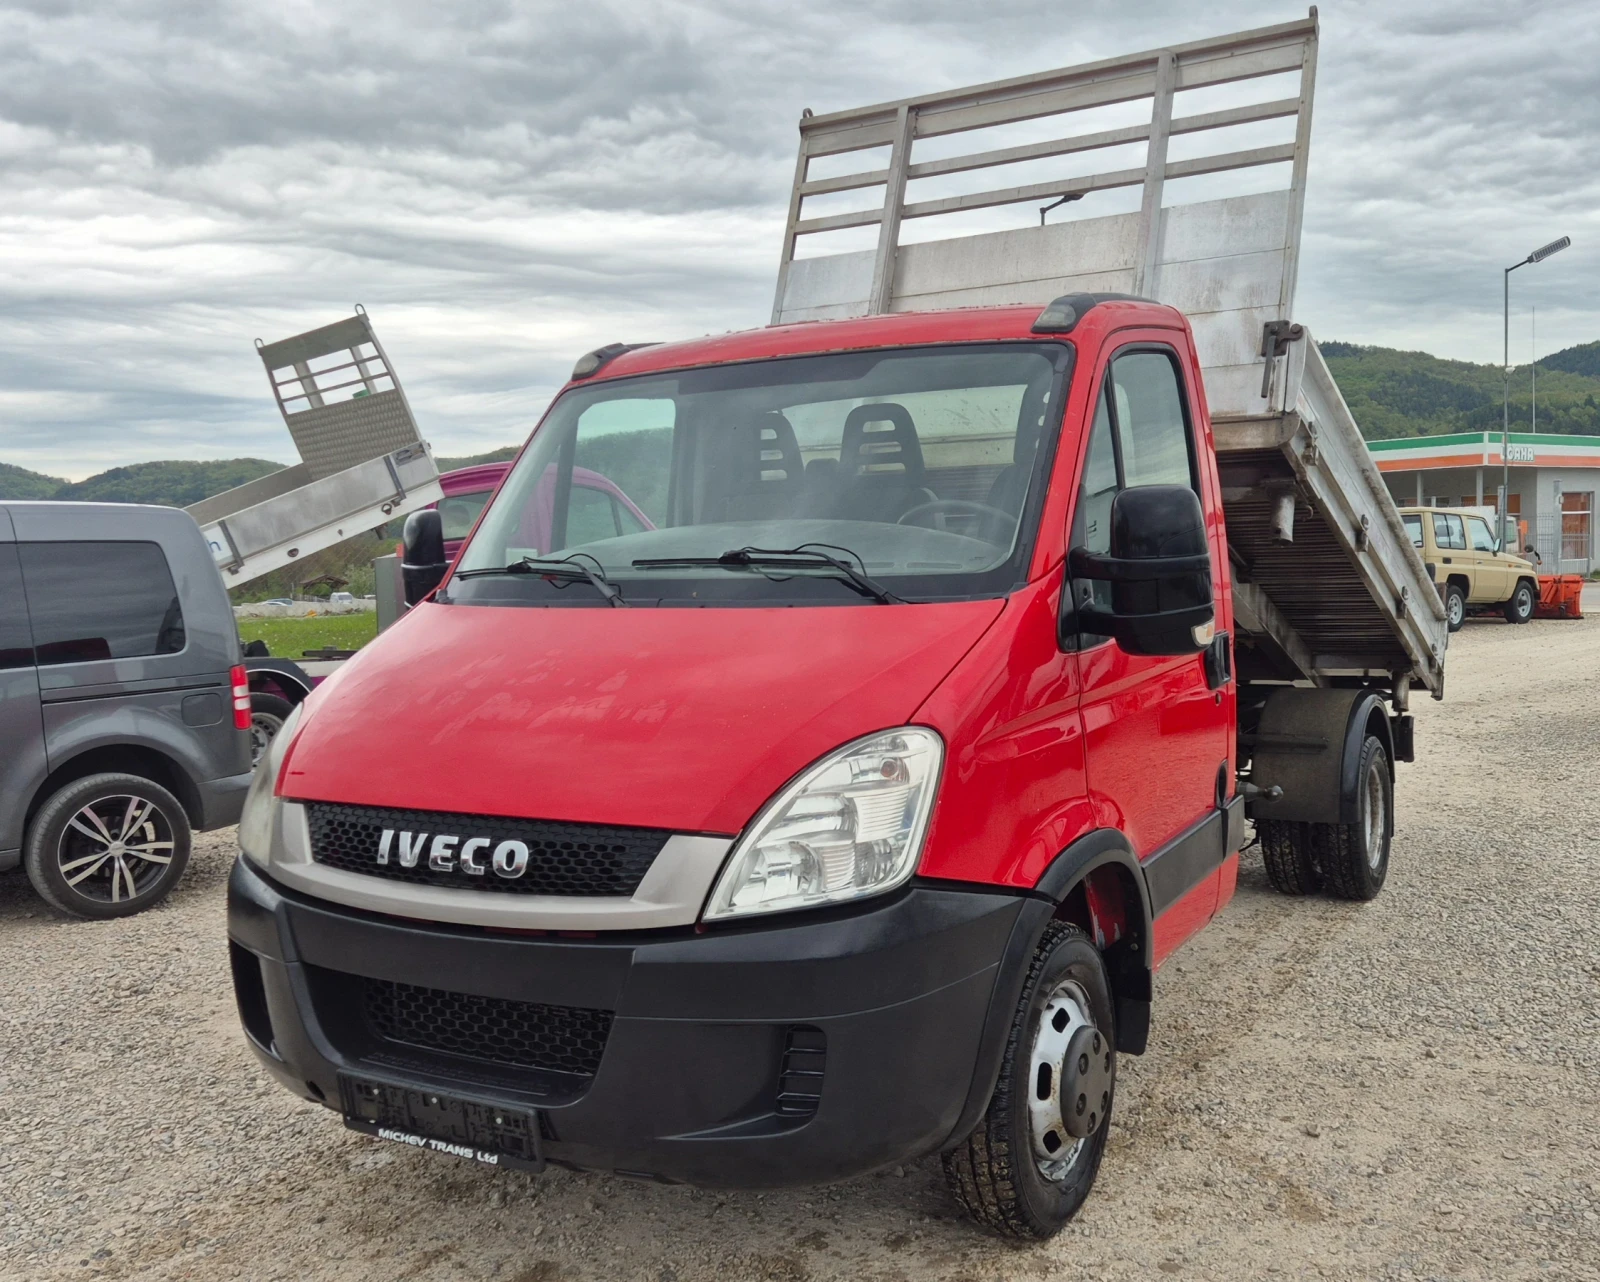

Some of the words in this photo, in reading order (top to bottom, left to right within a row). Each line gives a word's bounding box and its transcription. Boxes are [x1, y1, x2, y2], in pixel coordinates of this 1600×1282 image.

[377, 829, 529, 879] IVECO
[378, 1128, 427, 1147] MICHEV
[428, 1139, 473, 1158] TRANS
[477, 1151, 498, 1165] Ltd
